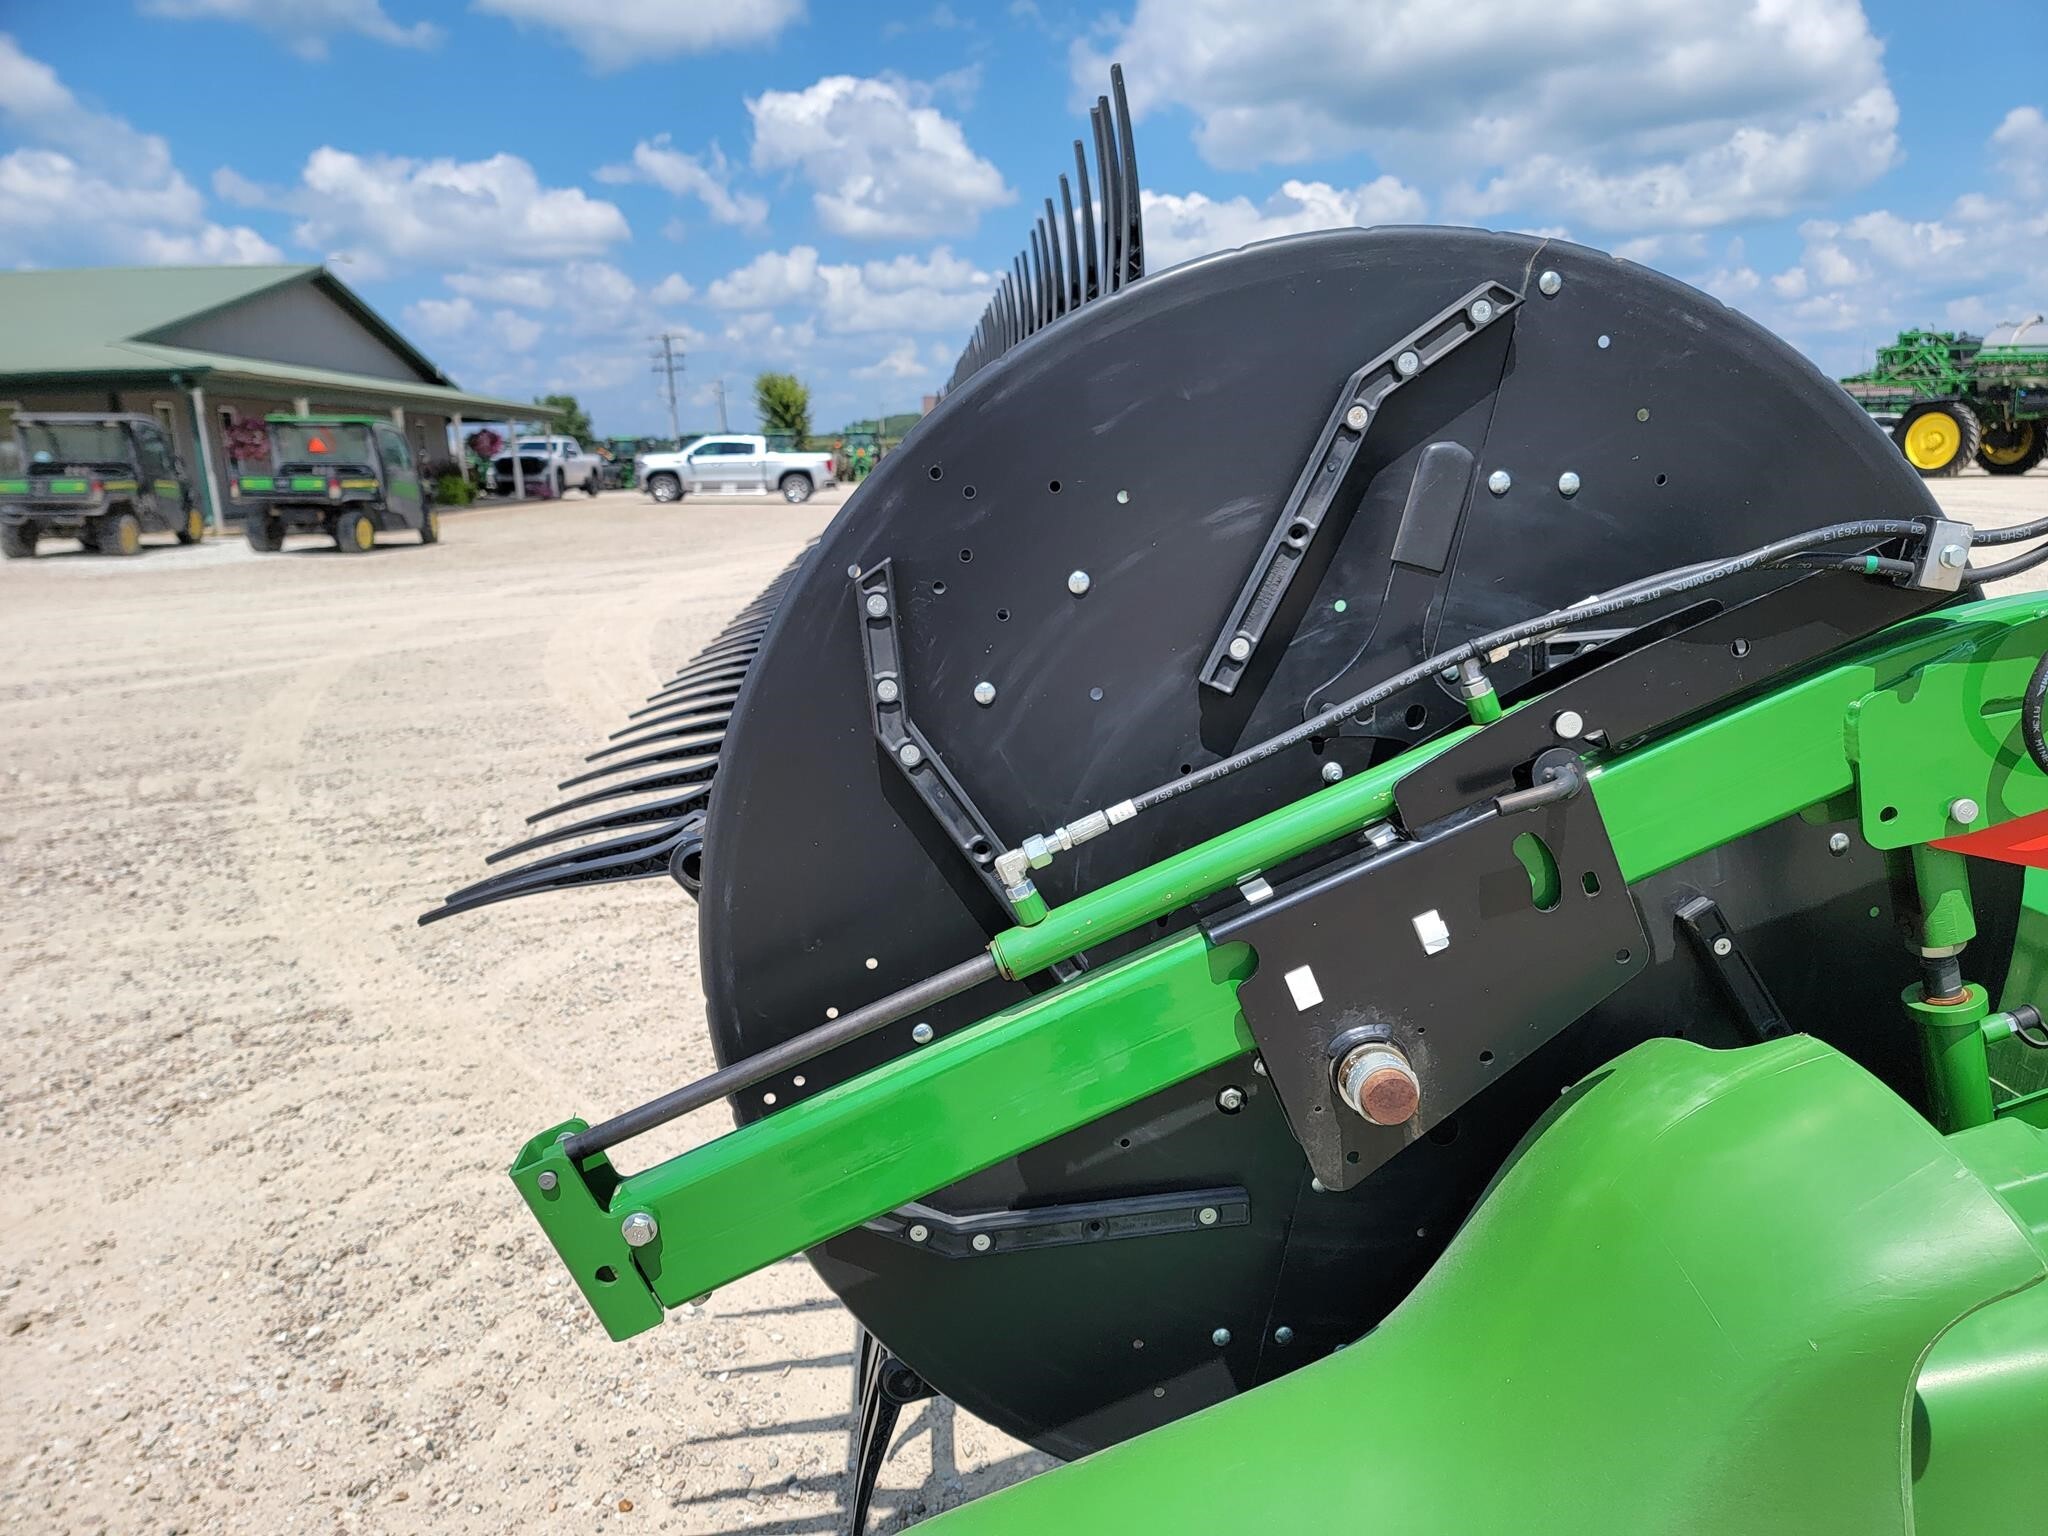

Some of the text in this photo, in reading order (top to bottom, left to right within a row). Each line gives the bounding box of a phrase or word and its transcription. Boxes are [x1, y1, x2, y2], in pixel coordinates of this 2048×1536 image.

[1884, 523, 1898, 533] 23
[2000, 527, 2031, 541] MSHA
[1668, 557, 1758, 592] ALFAGOMMA
[1631, 589, 1660, 606] AT3K
[1457, 649, 1471, 661] WP
[1423, 656, 1451, 676] 22.5
[1399, 672, 1419, 686] MPa
[1362, 686, 1393, 706] (3300
[1333, 703, 1358, 721] PSI)
[1281, 720, 1327, 746] exceeds
[1259, 744, 1279, 760] SAE
[1234, 756, 1252, 769] 100
[1209, 766, 1229, 780] R17
[1178, 781, 1193, 793] EN
[1154, 789, 1174, 804] 857
